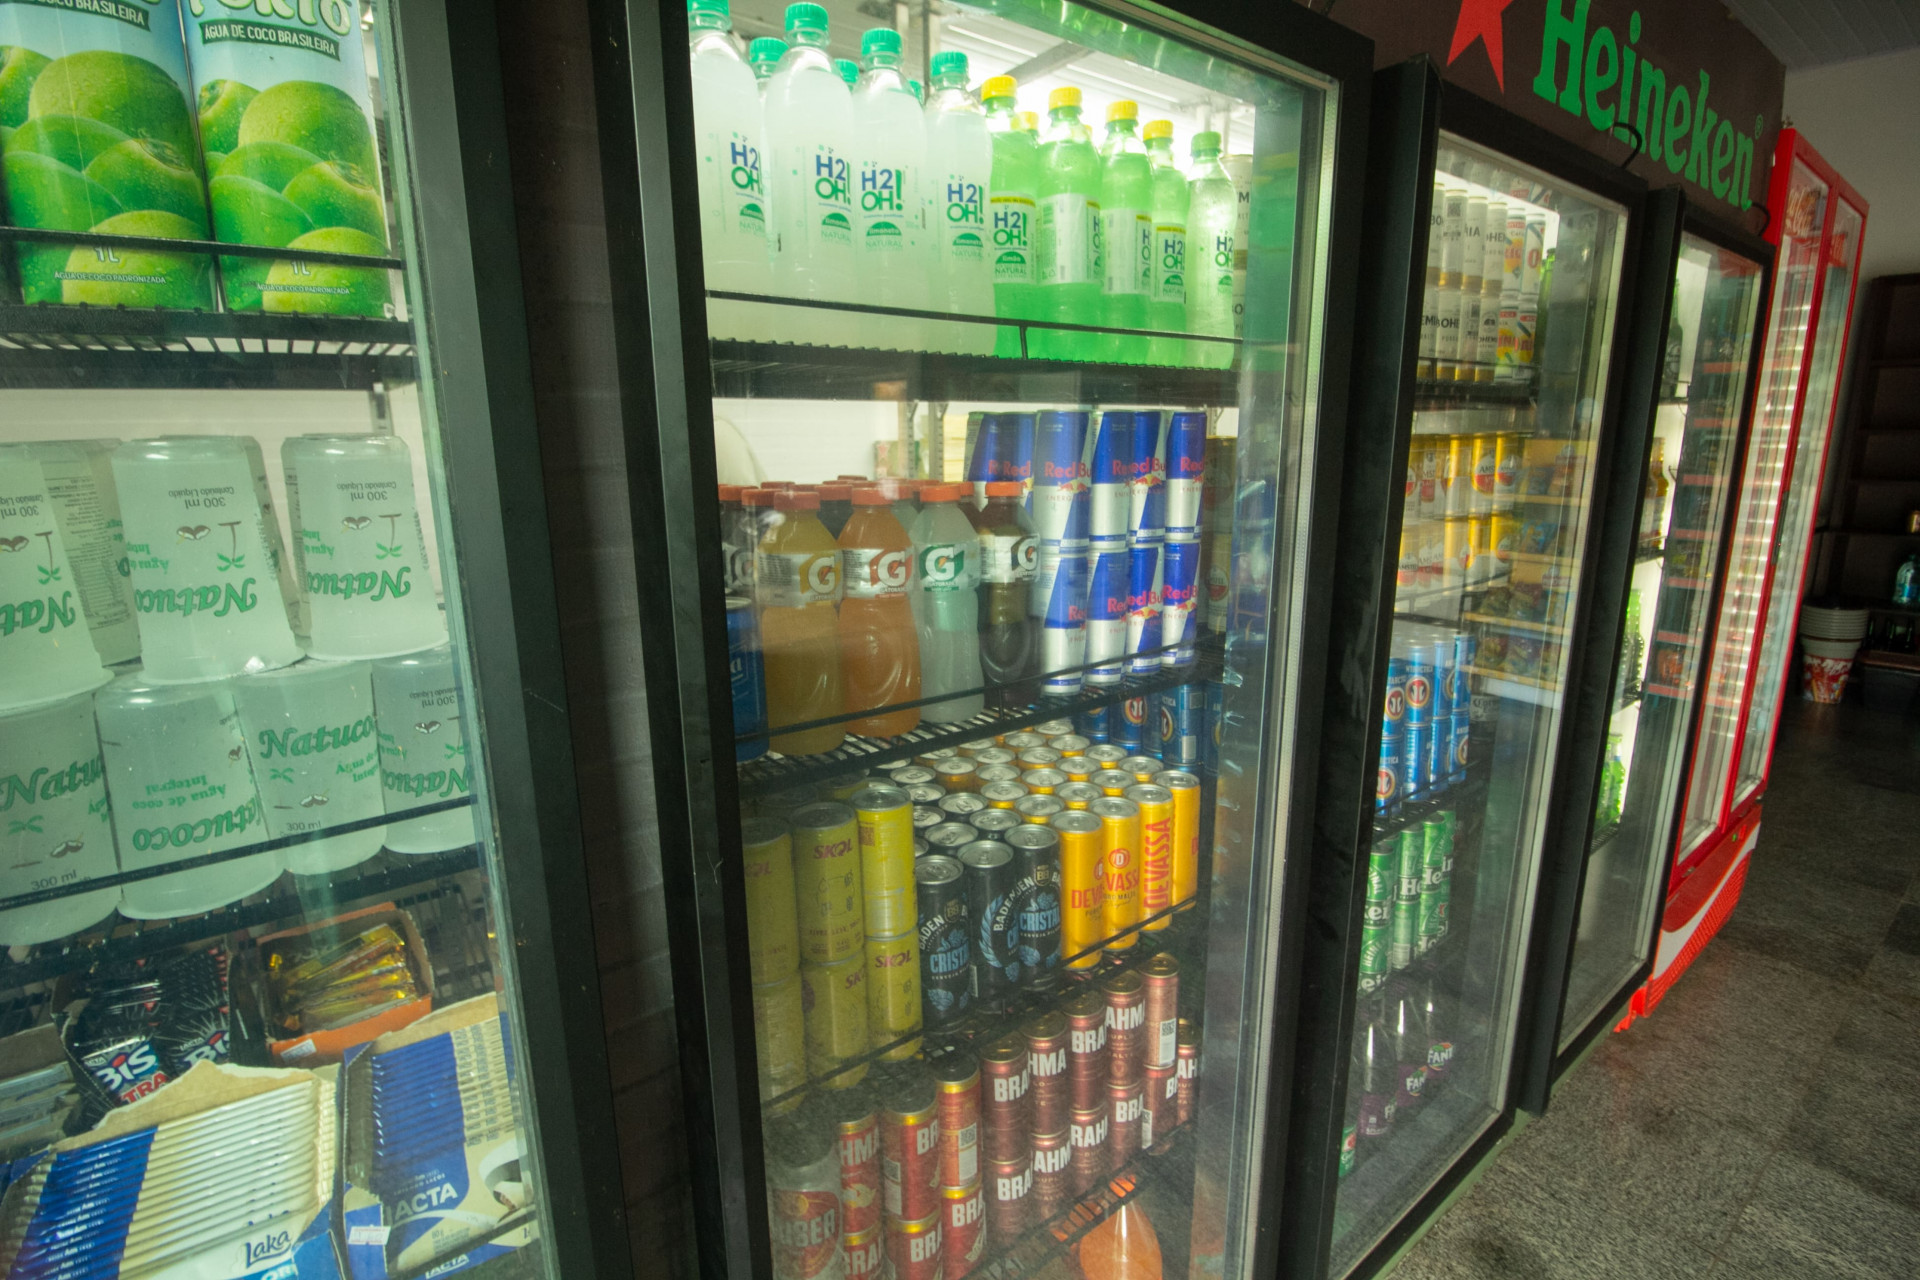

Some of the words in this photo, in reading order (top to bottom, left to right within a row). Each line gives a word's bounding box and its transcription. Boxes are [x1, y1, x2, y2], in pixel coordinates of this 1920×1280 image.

[204, 24, 228, 40] ÁGUA
[231, 25, 244, 38] DE
[247, 27, 276, 42] COCO
[278, 31, 336, 56] BRASILEIRA
[1533, 0, 1752, 211] Heineken
[816, 154, 847, 182] H2
[862, 168, 893, 191] H2
[947, 183, 979, 204] H2
[994, 211, 1021, 229] H2
[1045, 461, 1076, 478] Red
[185, 499, 202, 509] ml
[204, 497, 226, 508] 300
[350, 492, 364, 502] ml
[367, 490, 388, 502] 300
[18, 504, 39, 517] 300
[877, 550, 906, 588] G
[925, 545, 955, 583] G
[808, 556, 836, 594] G
[436, 695, 456, 707] 300
[146, 774, 208, 796] Integral
[190, 783, 226, 800] Água
[131, 800, 163, 810] coco
[167, 795, 187, 807] de
[132, 796, 260, 852] atucoco
[287, 822, 306, 832] 300
[814, 838, 853, 860] SKOL
[1143, 817, 1171, 908] DEVASSA
[31, 874, 58, 892] 300
[61, 869, 77, 884] ml
[875, 950, 912, 968] SKOL
[245, 1230, 291, 1269] Laka
[425, 1253, 470, 1280] LACTA
